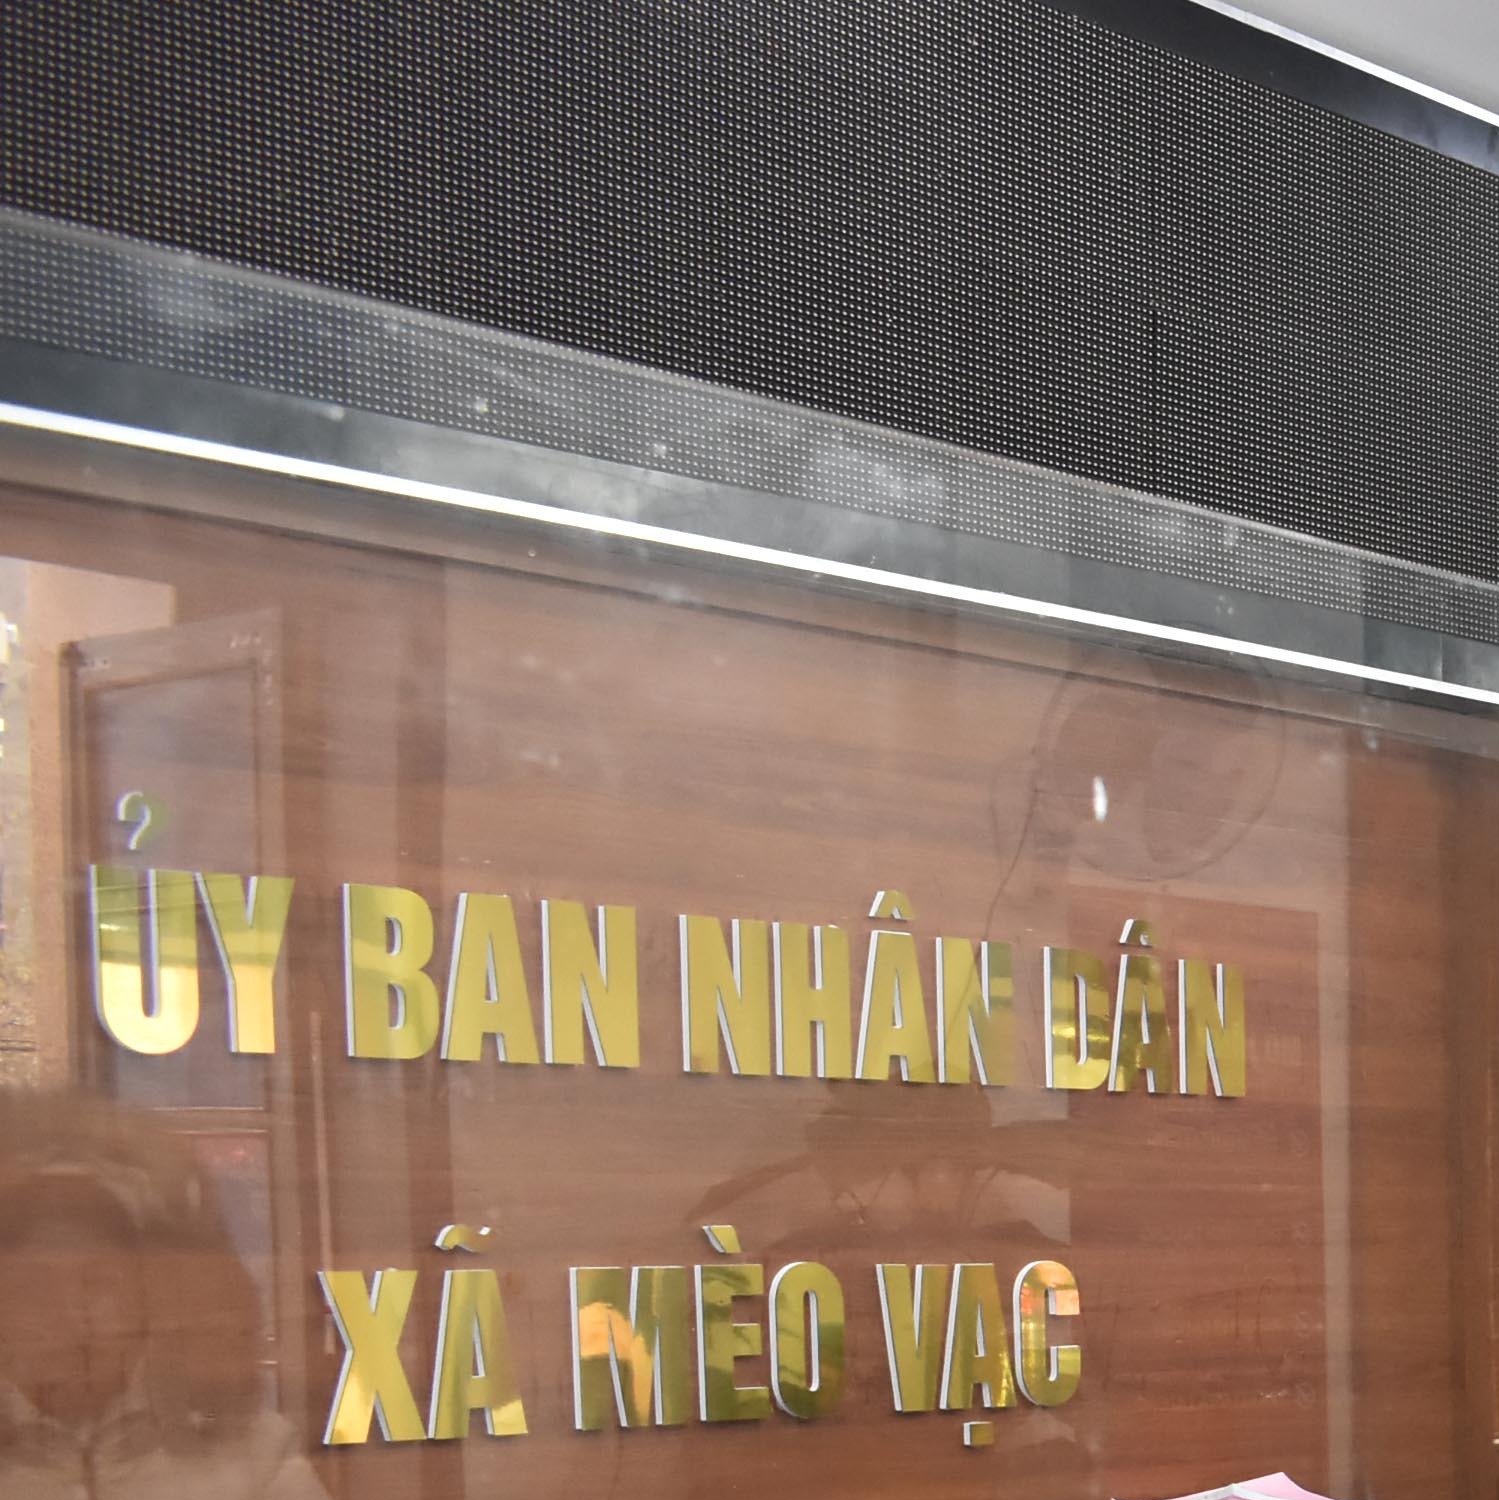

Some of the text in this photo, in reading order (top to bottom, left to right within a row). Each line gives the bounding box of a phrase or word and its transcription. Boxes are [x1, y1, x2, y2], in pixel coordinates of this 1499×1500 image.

[88, 790, 1248, 1099] ỦY BAN NHÂN DÂN
[316, 1224, 1083, 1447] XÃ MÈO VẠC
